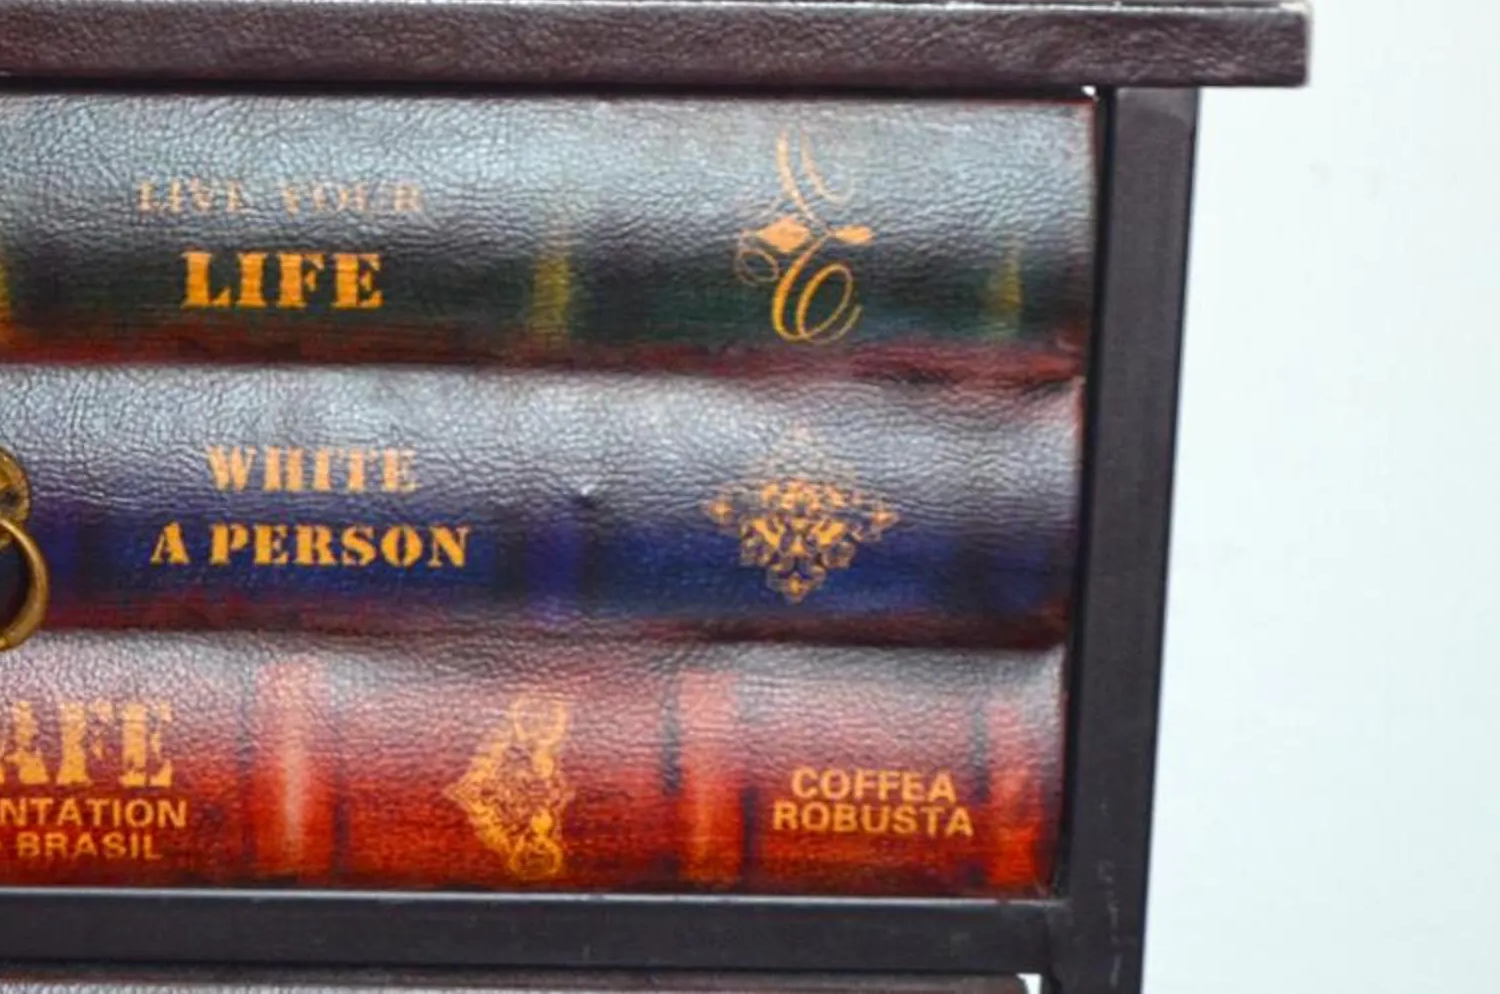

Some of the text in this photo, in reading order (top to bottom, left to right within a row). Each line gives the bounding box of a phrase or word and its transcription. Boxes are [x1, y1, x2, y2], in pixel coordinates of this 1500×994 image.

[181, 250, 384, 310] LIFE
[204, 445, 421, 494] WHITE
[150, 520, 472, 568] A PERSON
[790, 767, 957, 805] COFFEA
[771, 799, 975, 838] ROBUSTA
[15, 830, 164, 862] BRASIL
